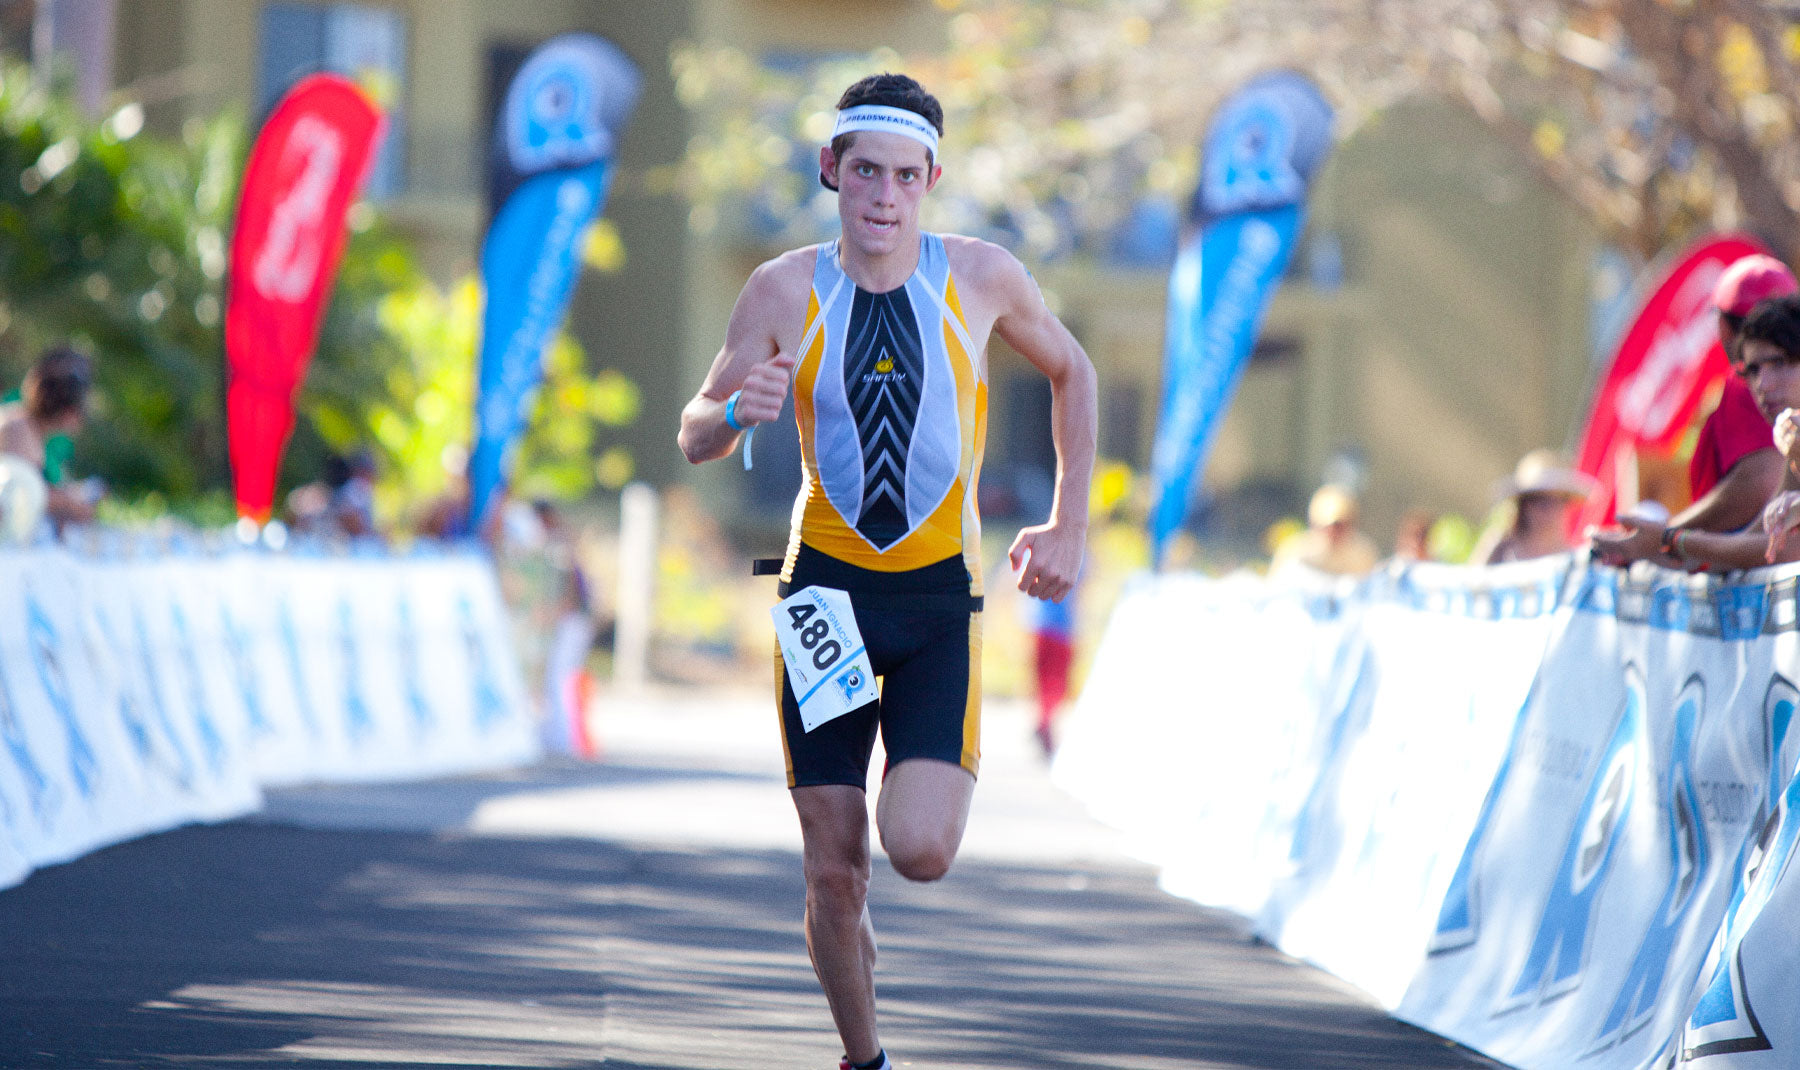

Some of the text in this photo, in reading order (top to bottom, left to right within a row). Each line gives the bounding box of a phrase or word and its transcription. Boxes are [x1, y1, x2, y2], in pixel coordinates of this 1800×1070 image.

[787, 603, 842, 671] 480
[808, 588, 853, 649] JUAN IGNACIO
